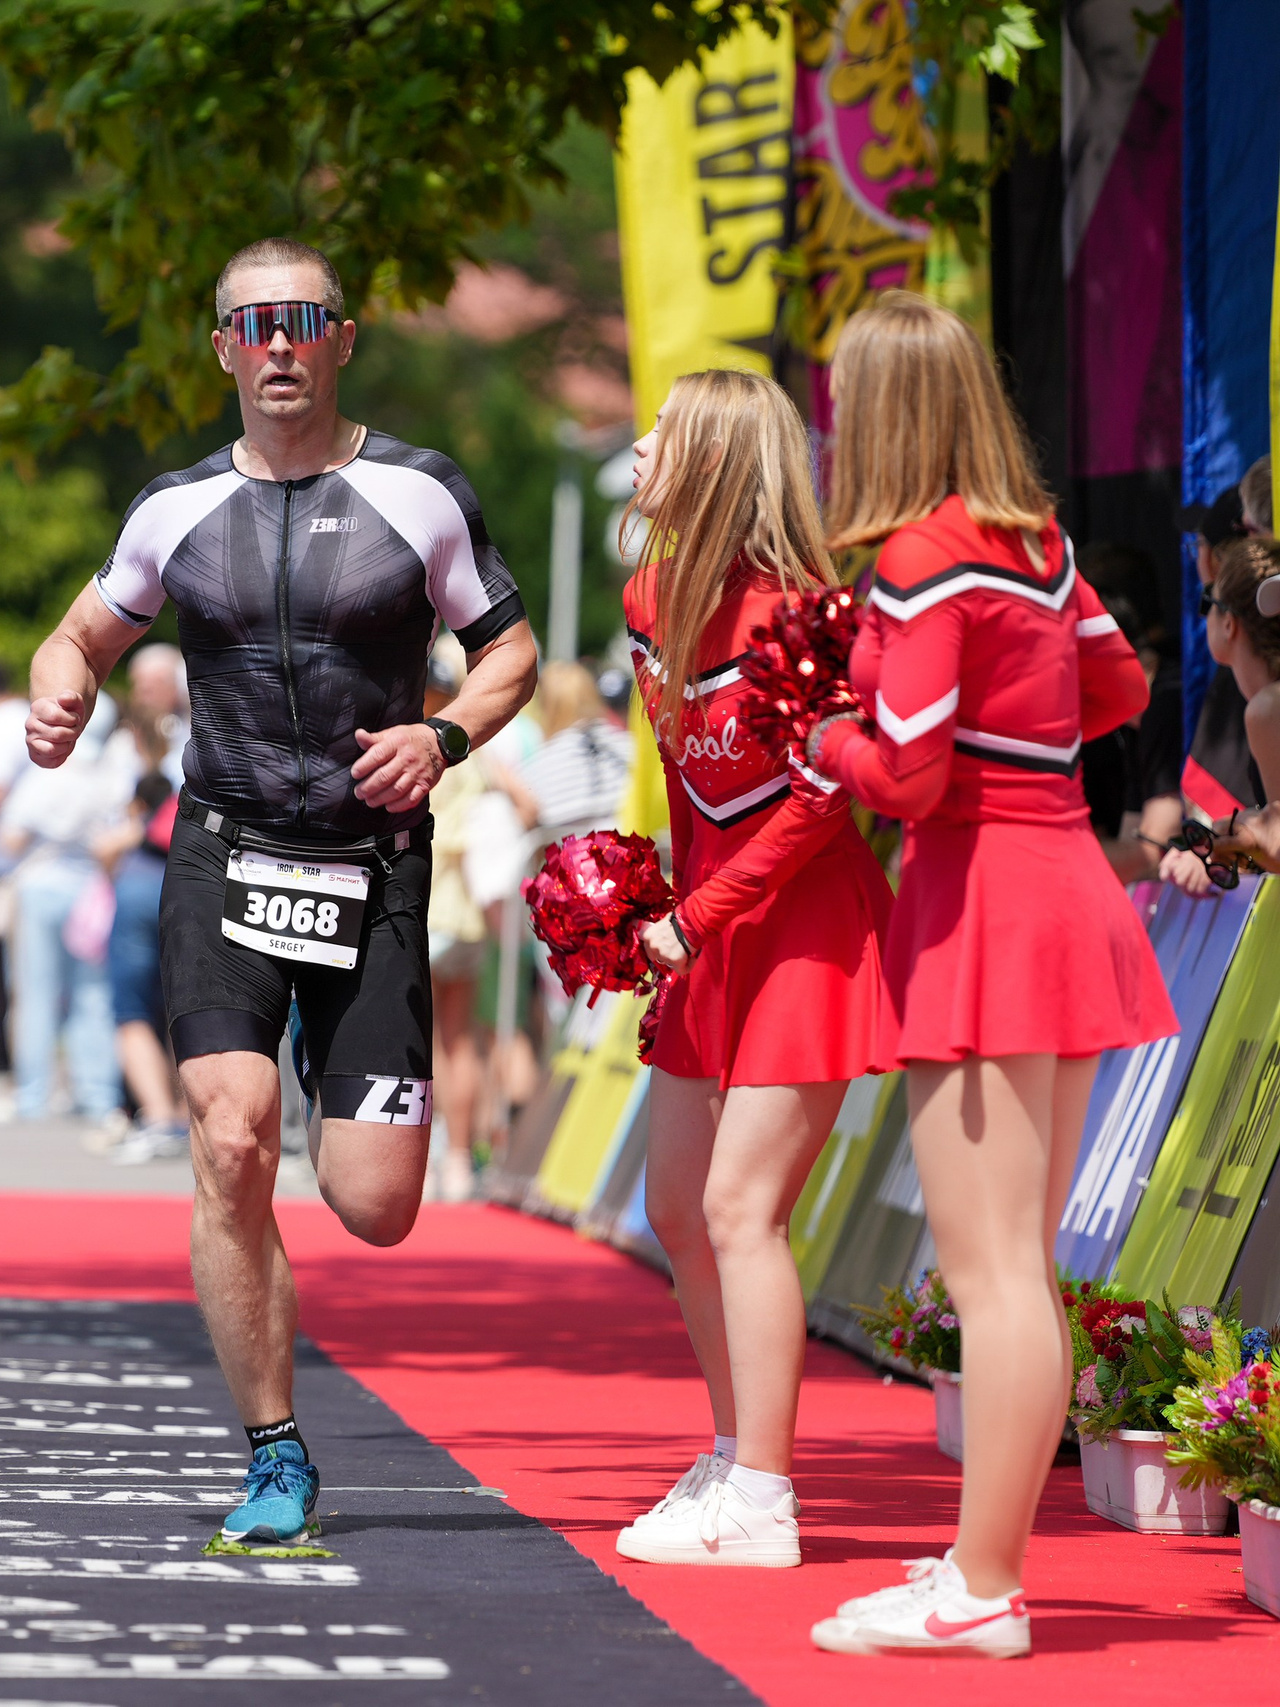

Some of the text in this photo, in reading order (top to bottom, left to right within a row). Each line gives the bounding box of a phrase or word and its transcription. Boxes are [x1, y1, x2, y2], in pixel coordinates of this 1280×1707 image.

[696, 72, 793, 285] STAR
[277, 863, 321, 877] IRON STAR
[243, 891, 340, 937] 3068
[269, 939, 306, 953] SERGEY
